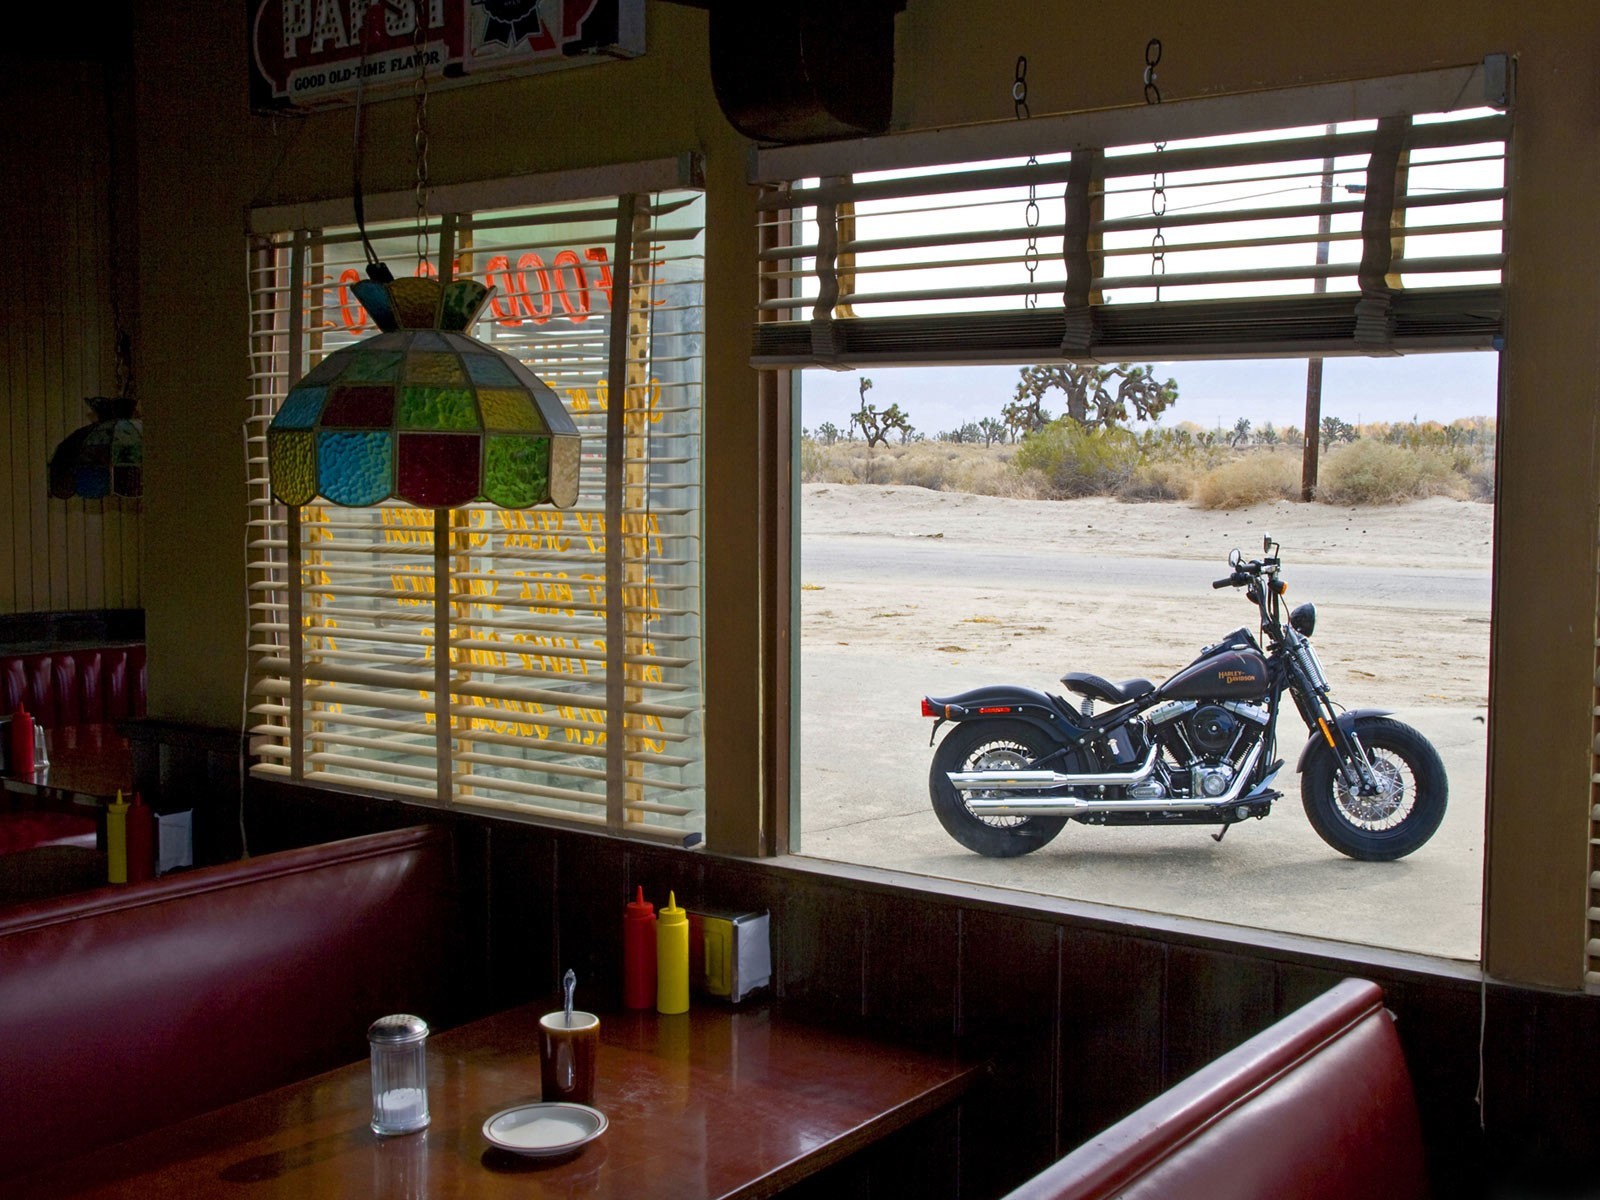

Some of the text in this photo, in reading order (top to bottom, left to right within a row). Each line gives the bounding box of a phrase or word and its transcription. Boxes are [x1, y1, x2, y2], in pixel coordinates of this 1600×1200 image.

[295, 74, 326, 91] GOOD
[329, 61, 386, 84] OLD-TIME
[1226, 675, 1256, 684] DAVIDSON
